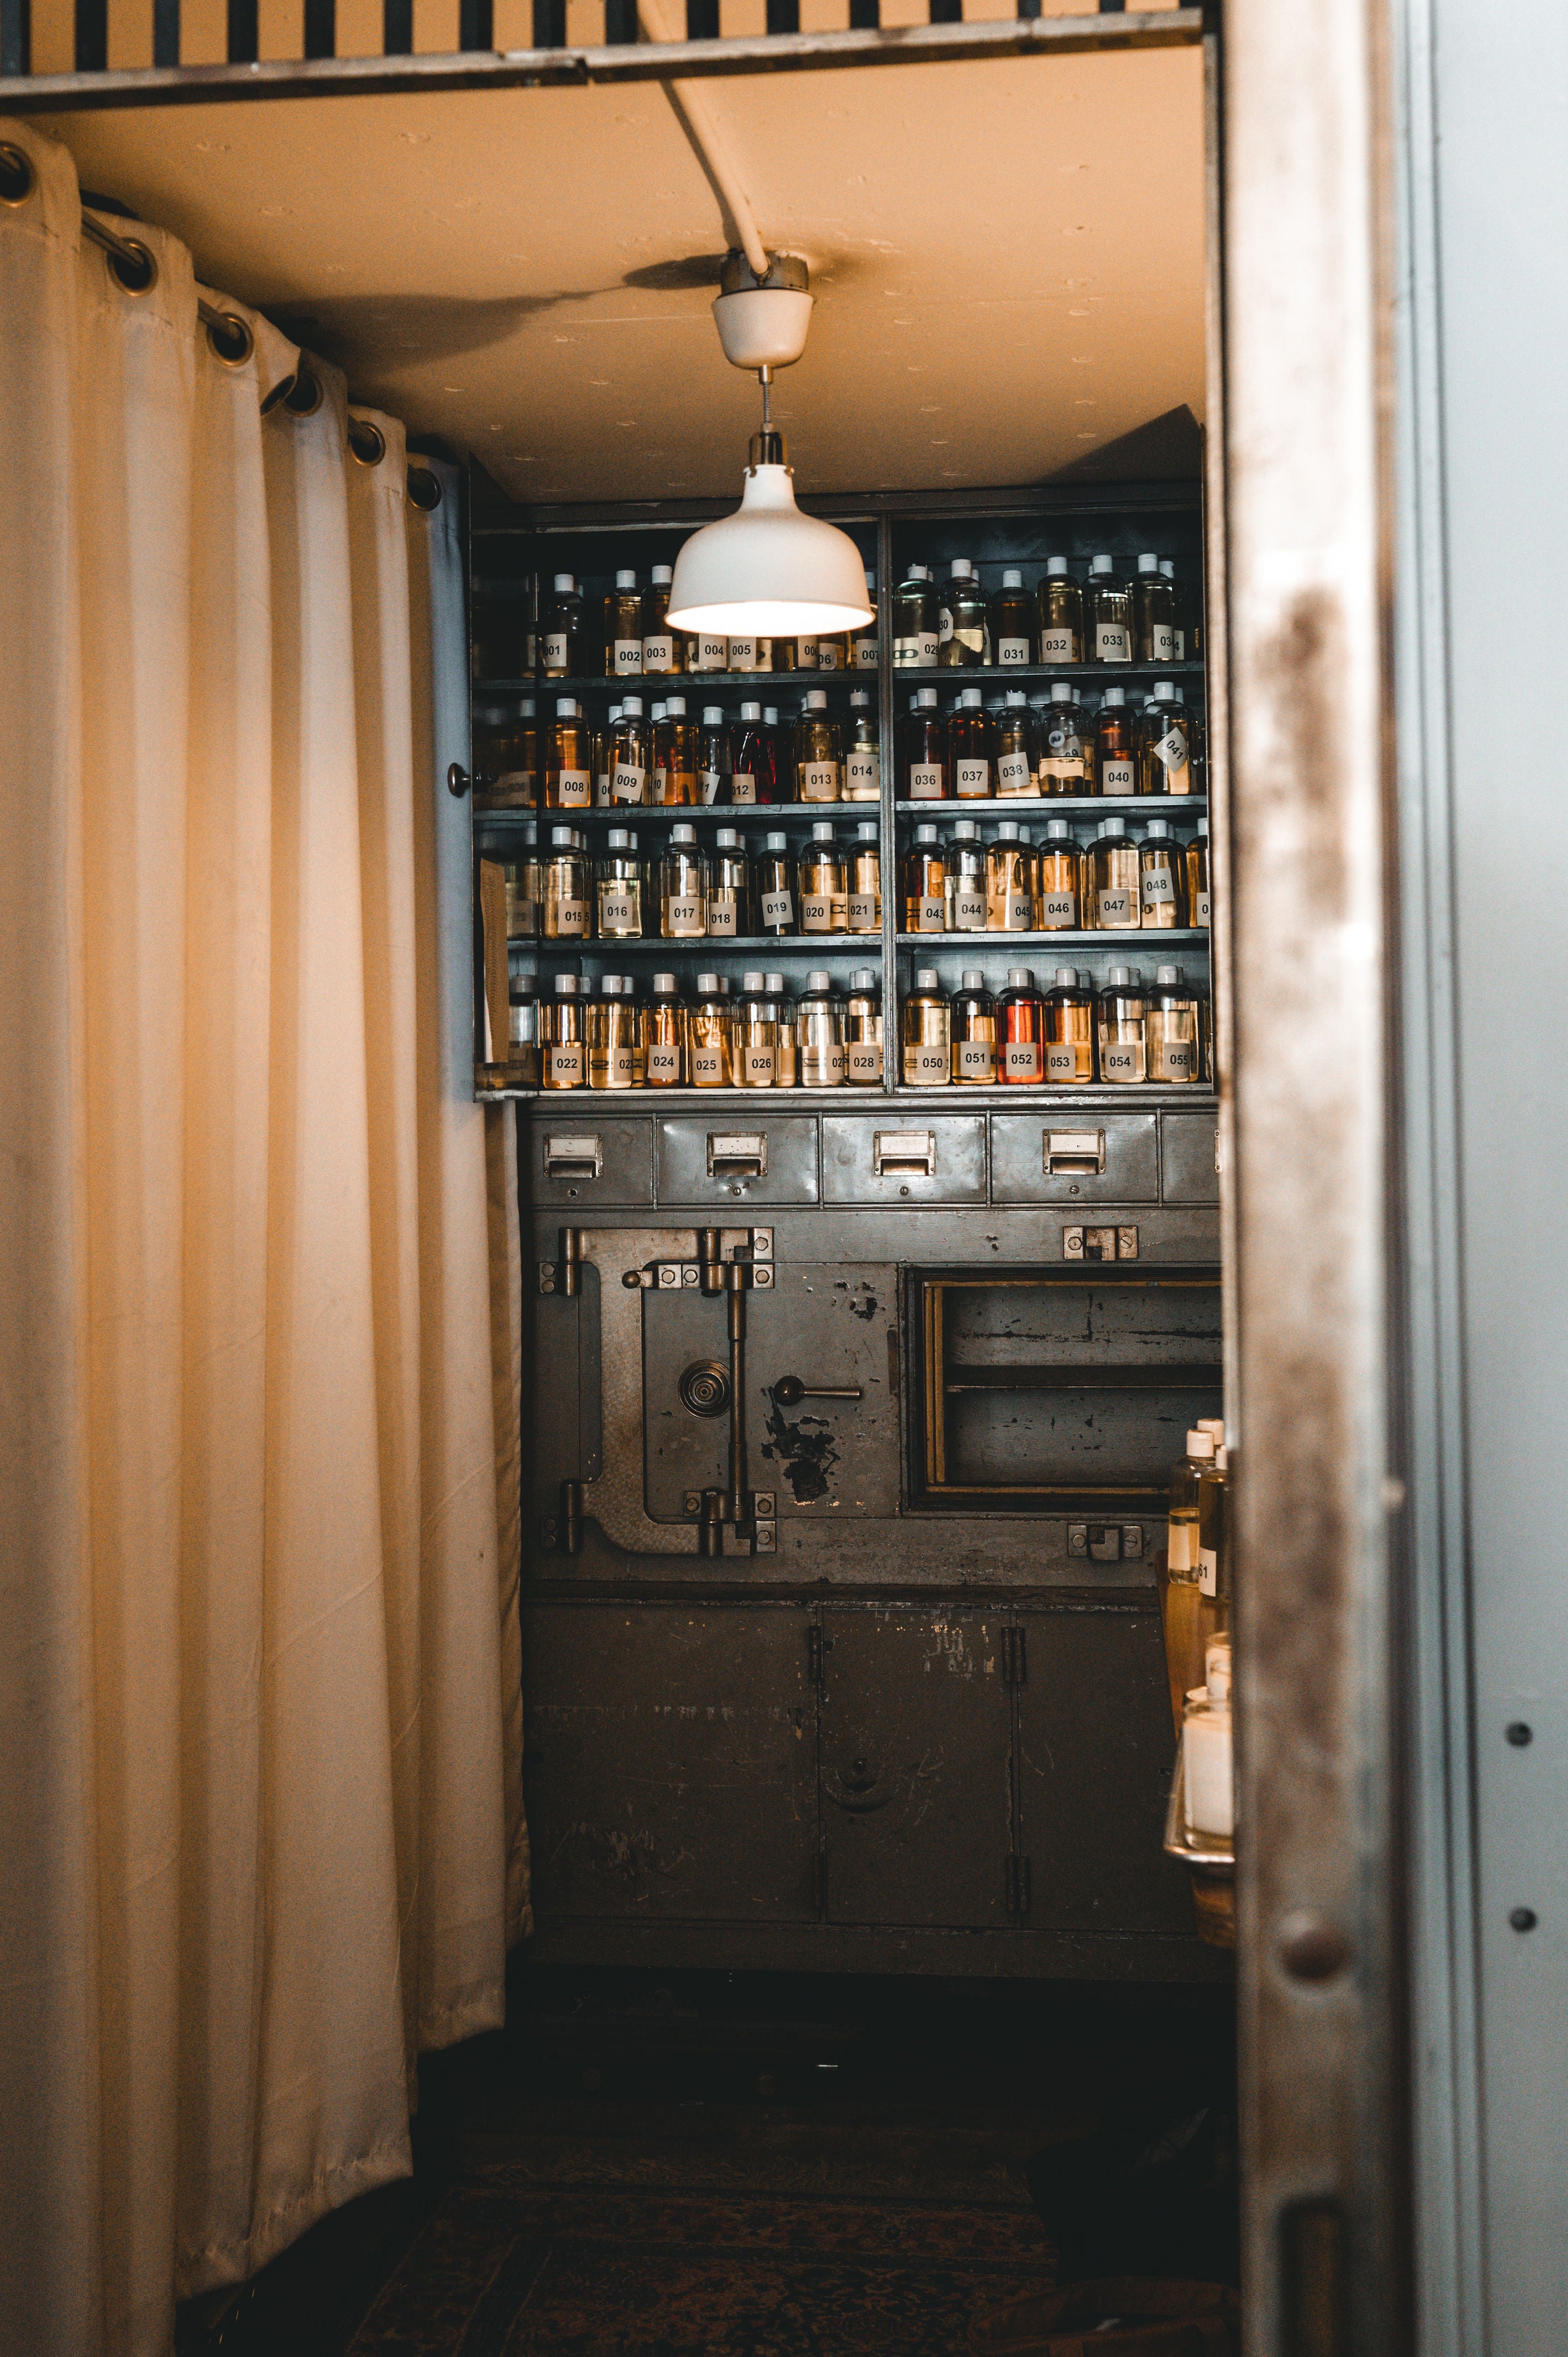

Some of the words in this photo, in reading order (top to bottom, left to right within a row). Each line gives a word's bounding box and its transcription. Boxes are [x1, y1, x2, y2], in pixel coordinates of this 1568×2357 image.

[1046, 640, 1067, 650] 032
[1103, 635, 1122, 646] 033
[647, 648, 666, 658] 003
[704, 645, 724, 656] 004
[732, 645, 751, 655] 005
[1004, 649, 1023, 659] 031
[619, 651, 640, 661] 002
[1166, 740, 1184, 760] 041
[852, 765, 873, 776] 014
[962, 771, 983, 781] 037
[1002, 765, 1023, 777] 038
[617, 775, 637, 788] 009
[811, 774, 831, 784] 013
[915, 775, 936, 785] 036
[1108, 772, 1129, 782] 040
[564, 781, 584, 792] 008
[1146, 879, 1167, 891] 048
[767, 902, 787, 914] 019
[850, 905, 868, 915] 021
[961, 904, 981, 915] 044
[1048, 903, 1069, 913] 046
[1104, 900, 1125, 911] 047
[565, 911, 582, 922] 015
[607, 906, 628, 917] 016
[674, 907, 695, 919] 017
[806, 907, 824, 917] 020
[1015, 906, 1030, 917] 045
[711, 913, 731, 924] 018
[556, 1058, 577, 1069] 022
[653, 1056, 674, 1067] 024
[752, 1058, 771, 1069] 026
[832, 1057, 843, 1068] 02
[854, 1057, 874, 1067] 028
[922, 1057, 943, 1068] 050
[965, 1053, 985, 1063] 051
[1011, 1054, 1032, 1065] 052
[1050, 1057, 1070, 1067] 053
[1110, 1056, 1131, 1067] 054
[1170, 1054, 1188, 1065] 055
[696, 1060, 717, 1070] 025
